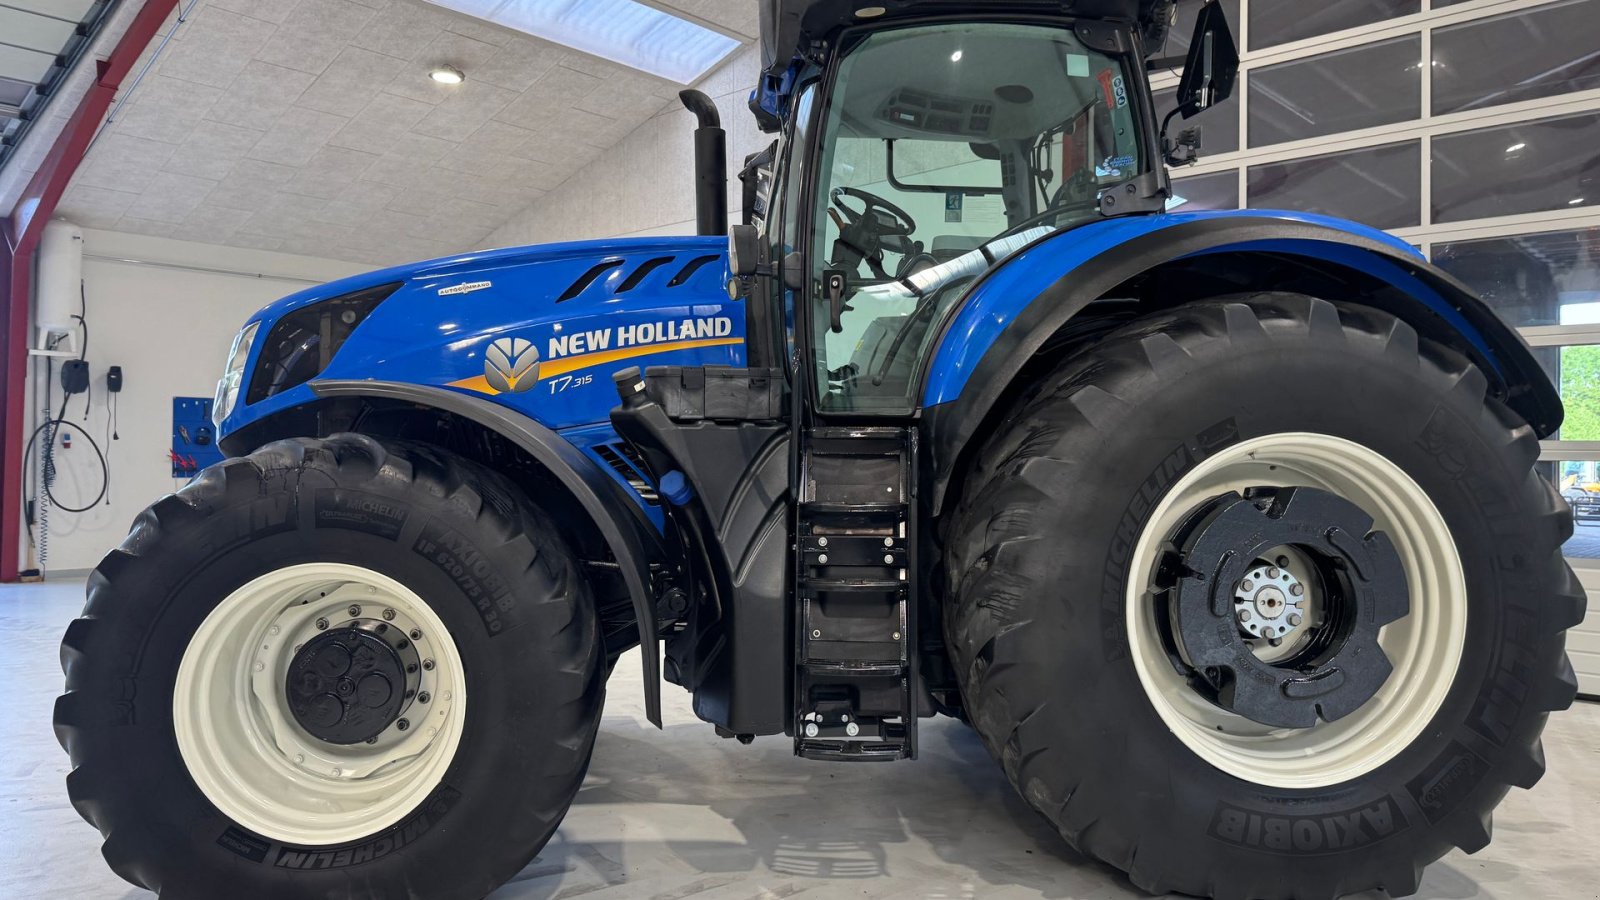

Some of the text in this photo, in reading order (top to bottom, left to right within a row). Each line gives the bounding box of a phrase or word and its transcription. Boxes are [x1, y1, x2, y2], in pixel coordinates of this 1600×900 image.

[548, 316, 732, 359] NEW HOLLAND
[548, 374, 593, 395] T7.315
[1101, 445, 1189, 614] MICHELIN
[436, 551, 482, 597] 620/75
[477, 596, 492, 611] R
[485, 609, 503, 632] 30
[438, 528, 517, 614] AXIOBIB
[275, 812, 433, 870] MICHELIN
[1215, 799, 1394, 850] AXIOBIB
